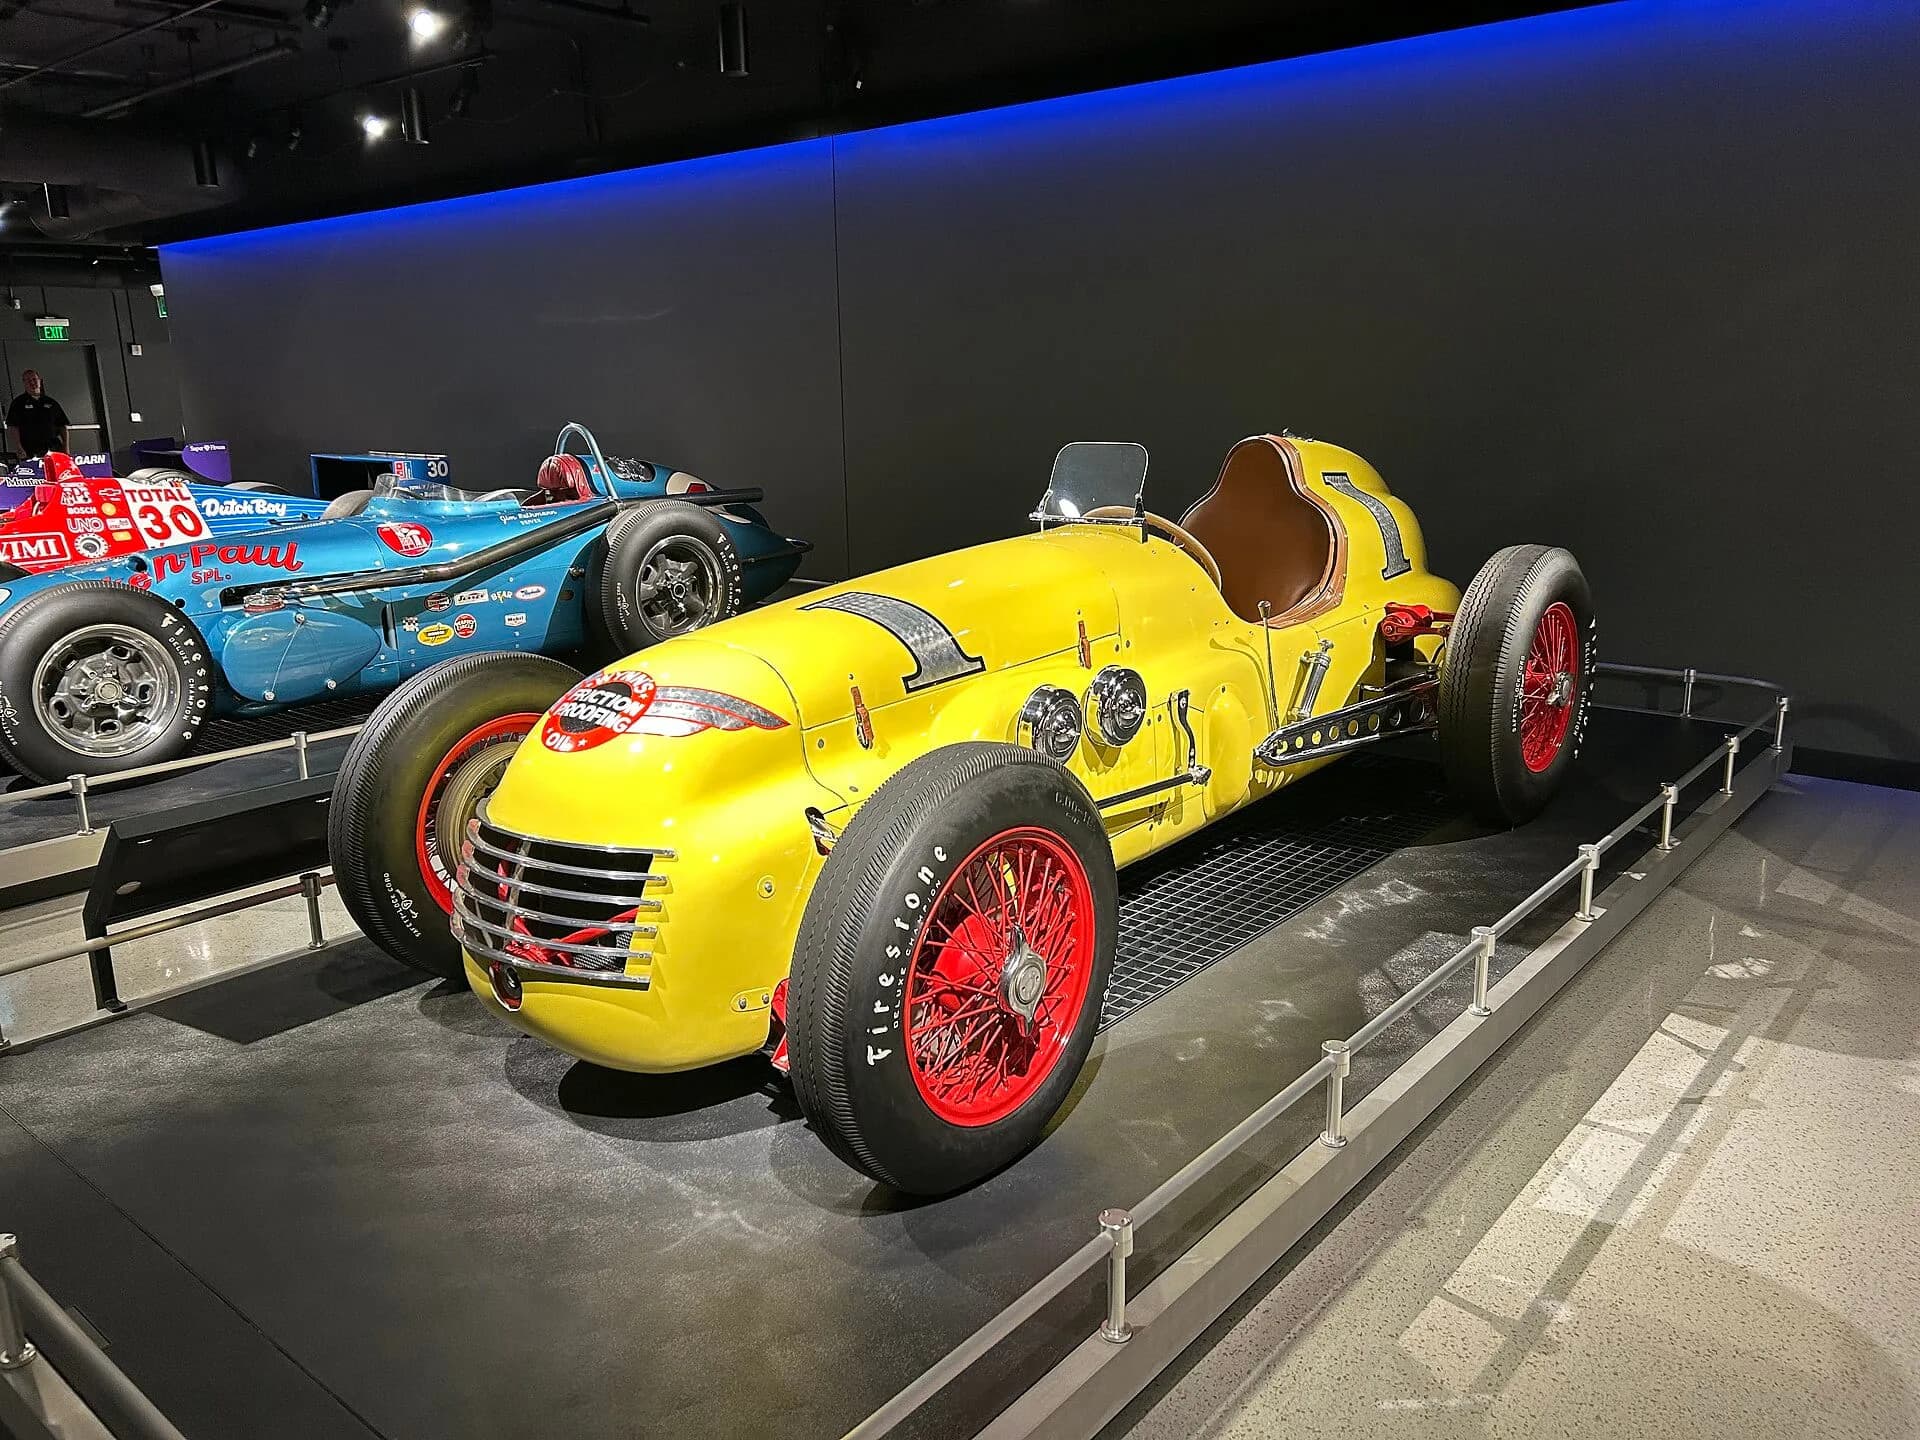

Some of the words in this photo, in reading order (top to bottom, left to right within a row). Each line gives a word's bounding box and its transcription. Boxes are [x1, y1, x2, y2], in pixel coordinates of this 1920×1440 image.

[44, 326, 64, 339] EXIT
[427, 461, 449, 477] 30
[67, 506, 97, 515] BOSCH
[125, 489, 191, 502] TOTAL
[201, 499, 253, 517] Dutch
[255, 499, 287, 517] Boy
[66, 517, 104, 533] UNO
[139, 505, 203, 540] 30
[1321, 472, 1411, 580] 1
[717, 533, 741, 617] Fireston
[490, 590, 513, 603] BEAR
[168, 637, 190, 666] DELUXE
[796, 591, 987, 694] 1
[161, 612, 209, 740] Firestone
[183, 678, 195, 721] CHAMPION
[567, 688, 645, 717] FRICTION
[552, 701, 632, 734] PROOFING
[905, 879, 942, 956] CHAMPION
[866, 846, 948, 1067] Firestone
[893, 967, 907, 1029] DELUXE
